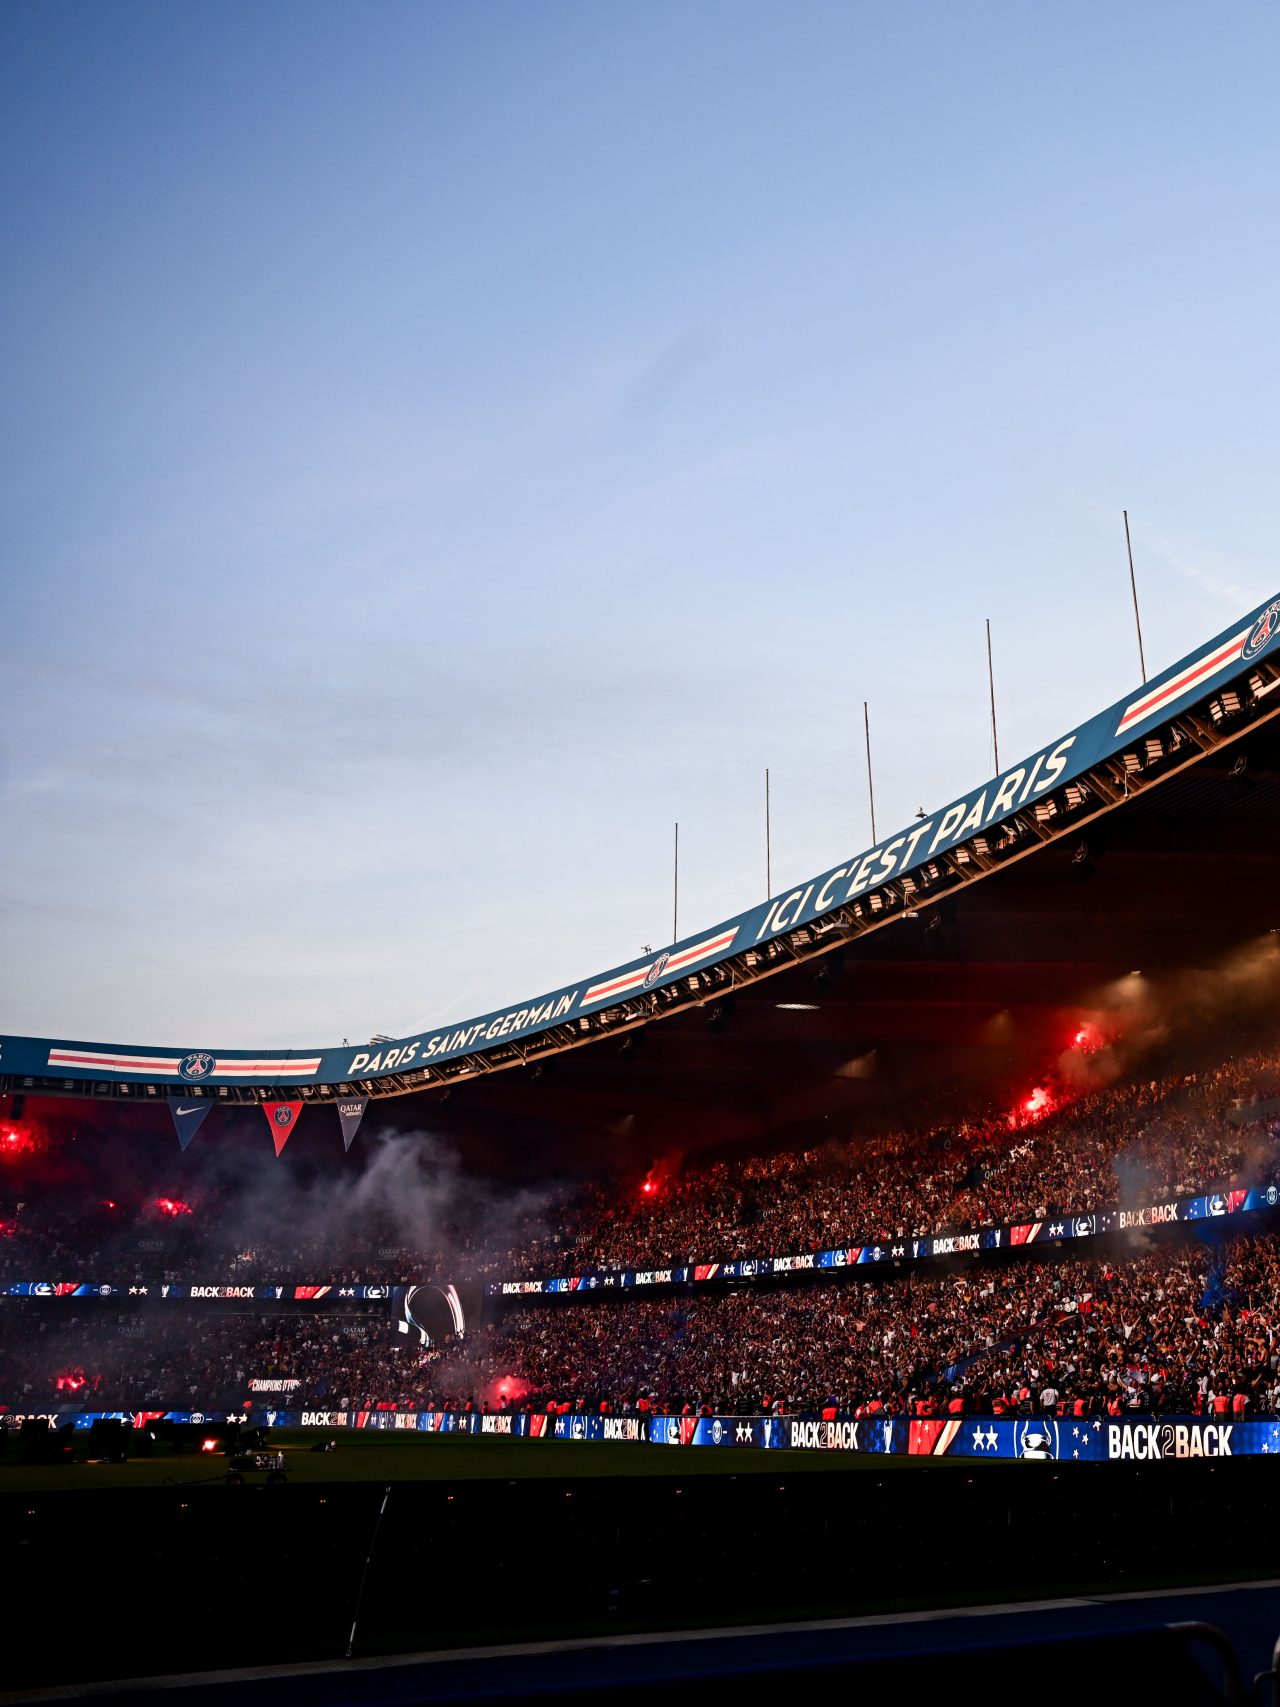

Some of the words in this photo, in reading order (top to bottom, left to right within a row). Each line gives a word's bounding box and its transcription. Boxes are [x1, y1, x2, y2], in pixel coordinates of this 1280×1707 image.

[755, 883, 815, 940] ICI
[814, 820, 933, 912] C'EST
[927, 735, 1077, 855] PARIS
[347, 1040, 420, 1075] PARIS
[421, 990, 578, 1059] SAINT-GERMAIN
[187, 1052, 211, 1062] PARIS
[340, 1103, 362, 1113] QATAR
[1119, 1202, 1178, 1229] BACK2BACK
[933, 1233, 980, 1255] BACK2BACK
[773, 1254, 815, 1272] BACK2BACK
[635, 1269, 672, 1285] BACK2BACK
[190, 1286, 255, 1298] BACK2BACK
[502, 1281, 543, 1294] BACK2BACK
[791, 1421, 859, 1450] BACK2BACK
[1109, 1424, 1234, 1460] BACK2BACK
